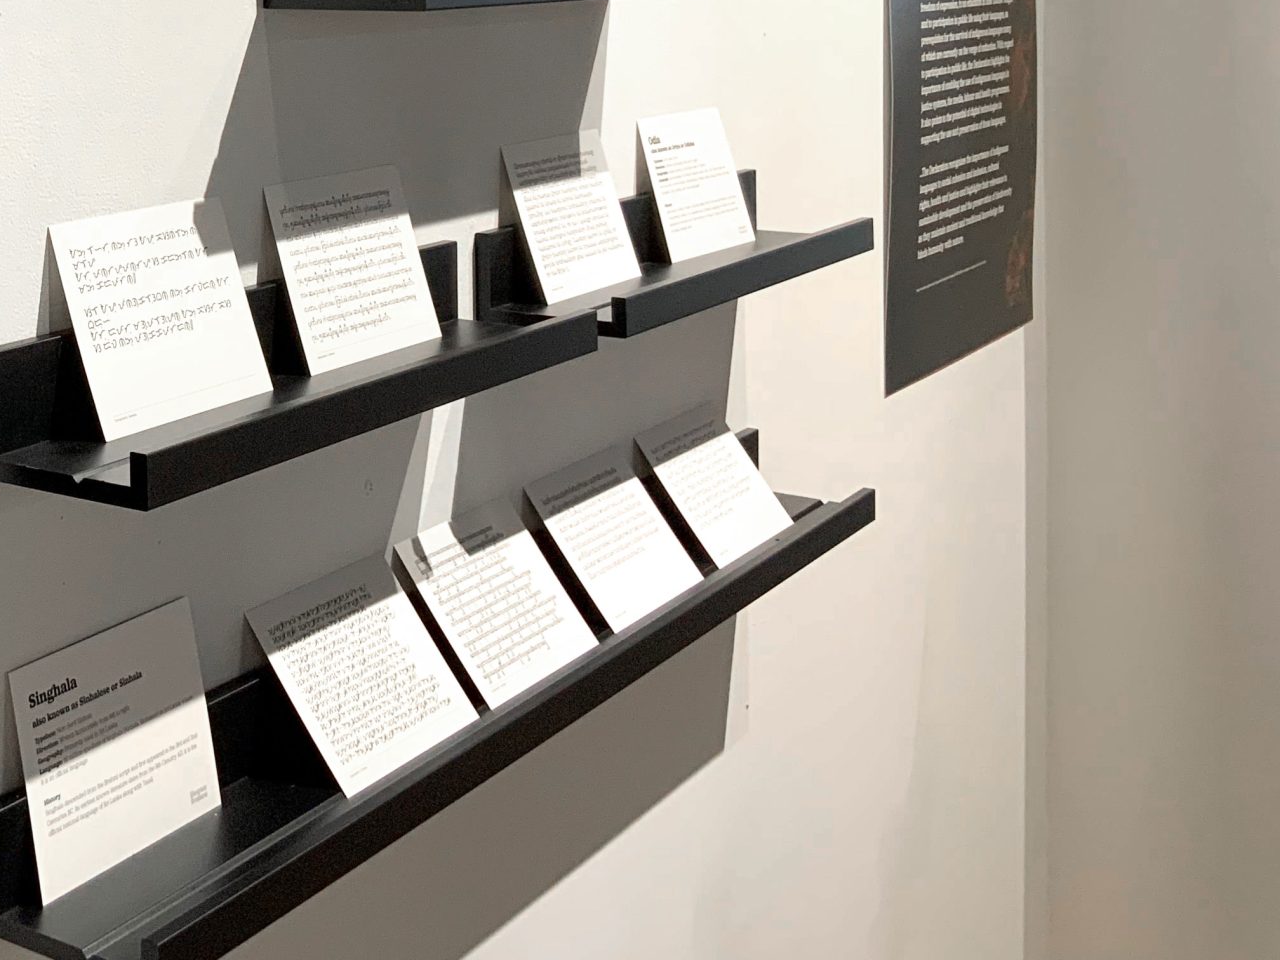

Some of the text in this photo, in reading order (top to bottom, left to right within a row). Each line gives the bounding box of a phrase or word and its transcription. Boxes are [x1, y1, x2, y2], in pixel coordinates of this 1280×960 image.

[28, 677, 78, 709] Singhala
[32, 715, 46, 729] also
[47, 704, 70, 722] known
[71, 701, 79, 711] as
[111, 682, 118, 692] or
